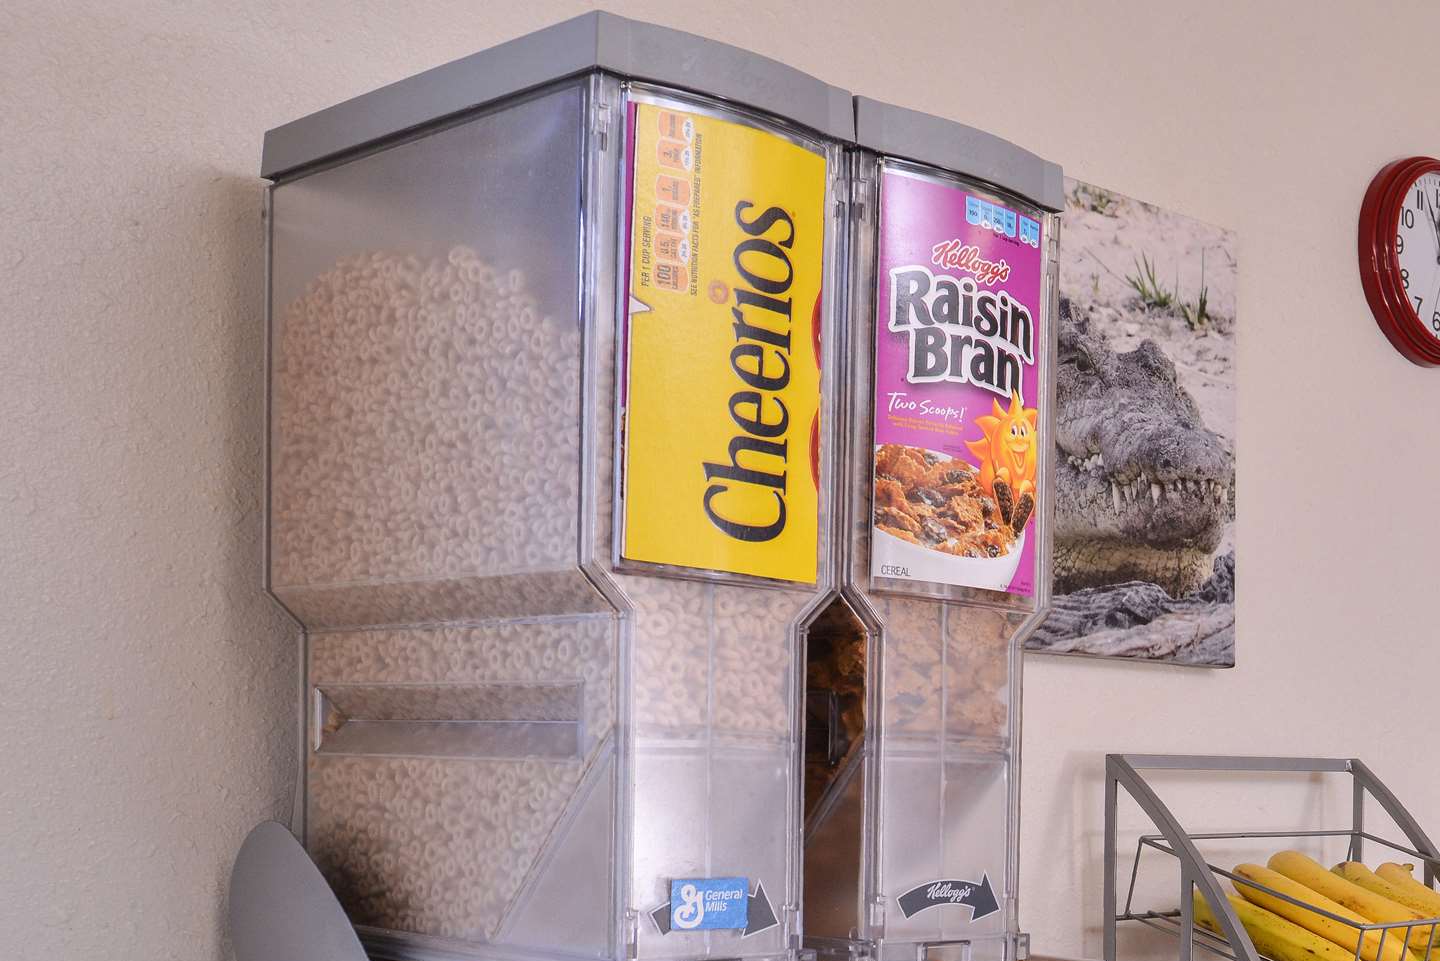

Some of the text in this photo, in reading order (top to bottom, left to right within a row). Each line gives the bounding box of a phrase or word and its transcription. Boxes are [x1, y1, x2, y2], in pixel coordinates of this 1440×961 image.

[1416, 190, 1424, 211] 11
[1401, 206, 1415, 229] 10
[1396, 234, 1404, 255] 9
[932, 239, 1010, 286] Kellogg's
[657, 265, 671, 285] 100
[1400, 268, 1410, 290] 8
[892, 268, 1033, 361] Raisin
[1414, 296, 1423, 317] 7
[1432, 311, 1440, 332] 6
[703, 199, 795, 543] Cheerios
[911, 326, 1020, 398] Bran
[888, 392, 917, 412] Two
[919, 399, 964, 422] Scoops!
[881, 564, 911, 577] CEREAL
[705, 889, 743, 901] General
[927, 882, 971, 903] Kellogg's
[705, 901, 728, 912] Mills
